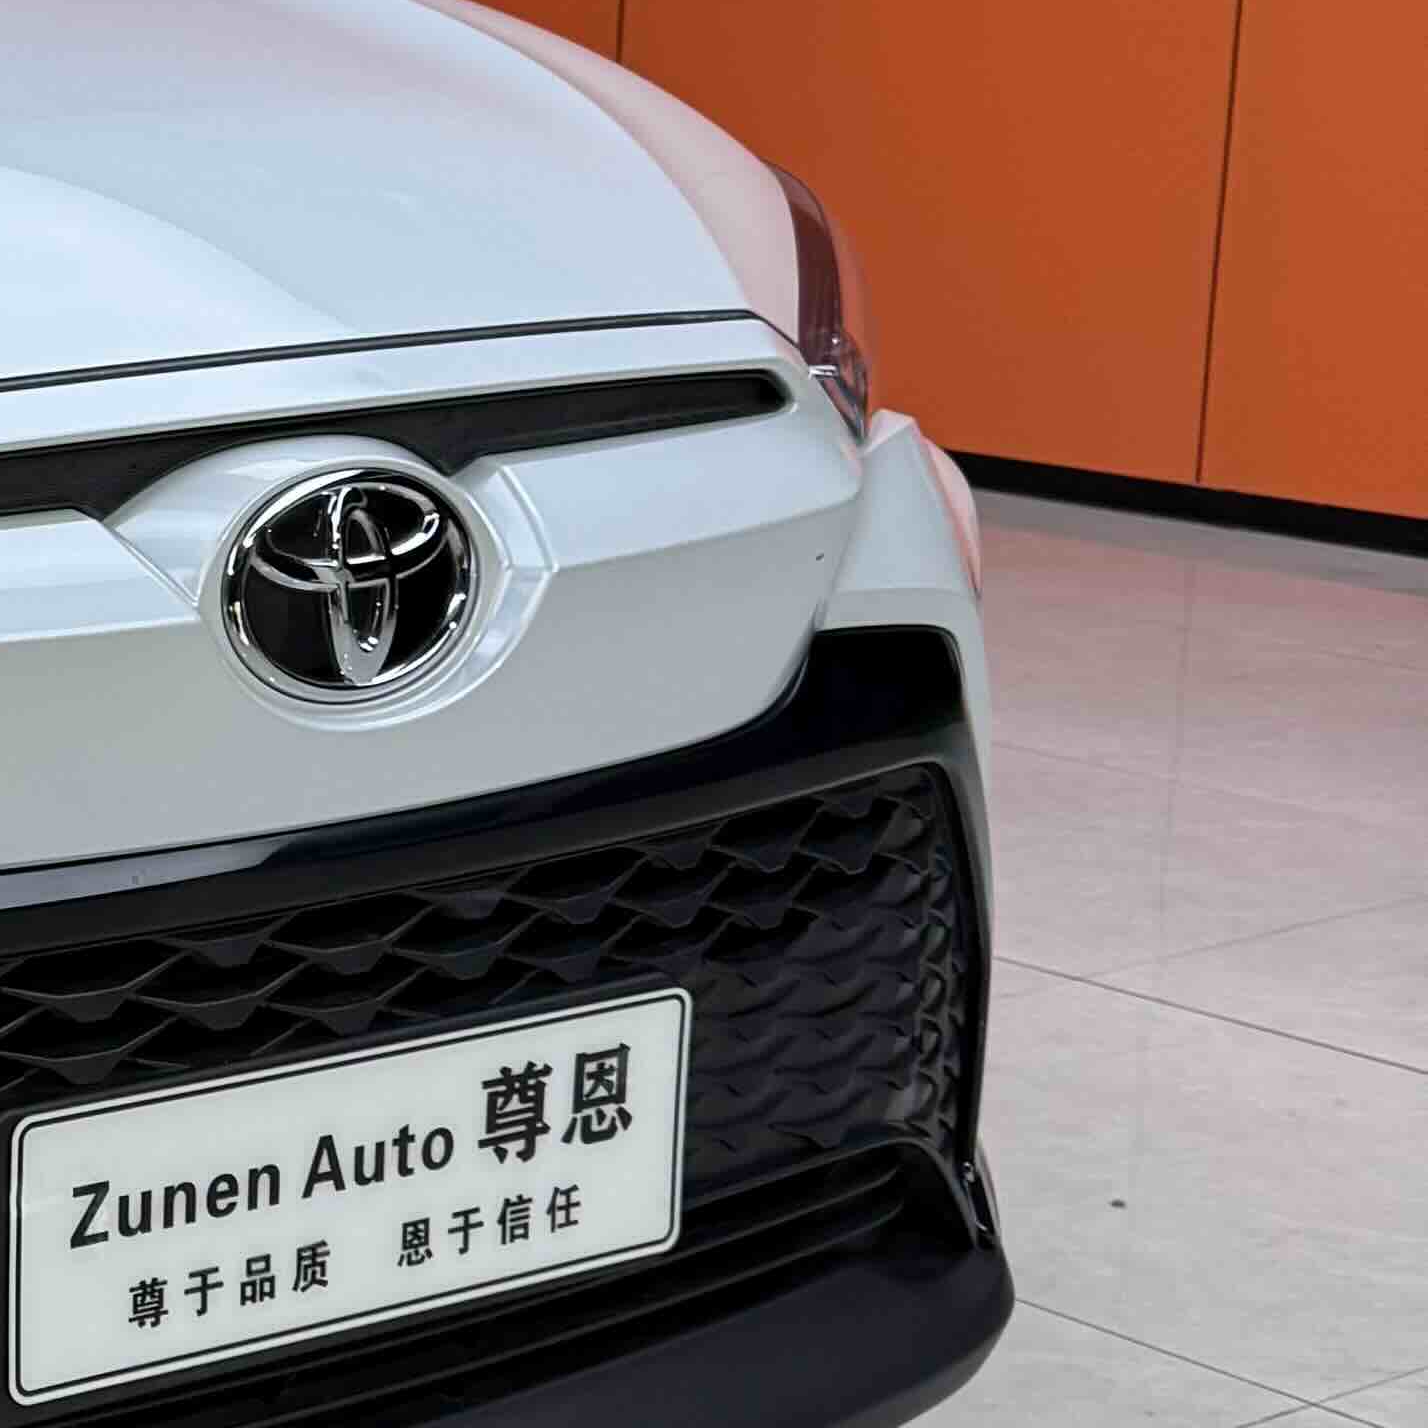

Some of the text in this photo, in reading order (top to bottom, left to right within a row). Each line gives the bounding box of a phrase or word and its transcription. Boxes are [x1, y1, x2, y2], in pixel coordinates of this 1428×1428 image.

[70, 1042, 634, 1249] Zunen Auto 尊恩
[128, 1183, 582, 1329] 尊于品质 恩于信任
